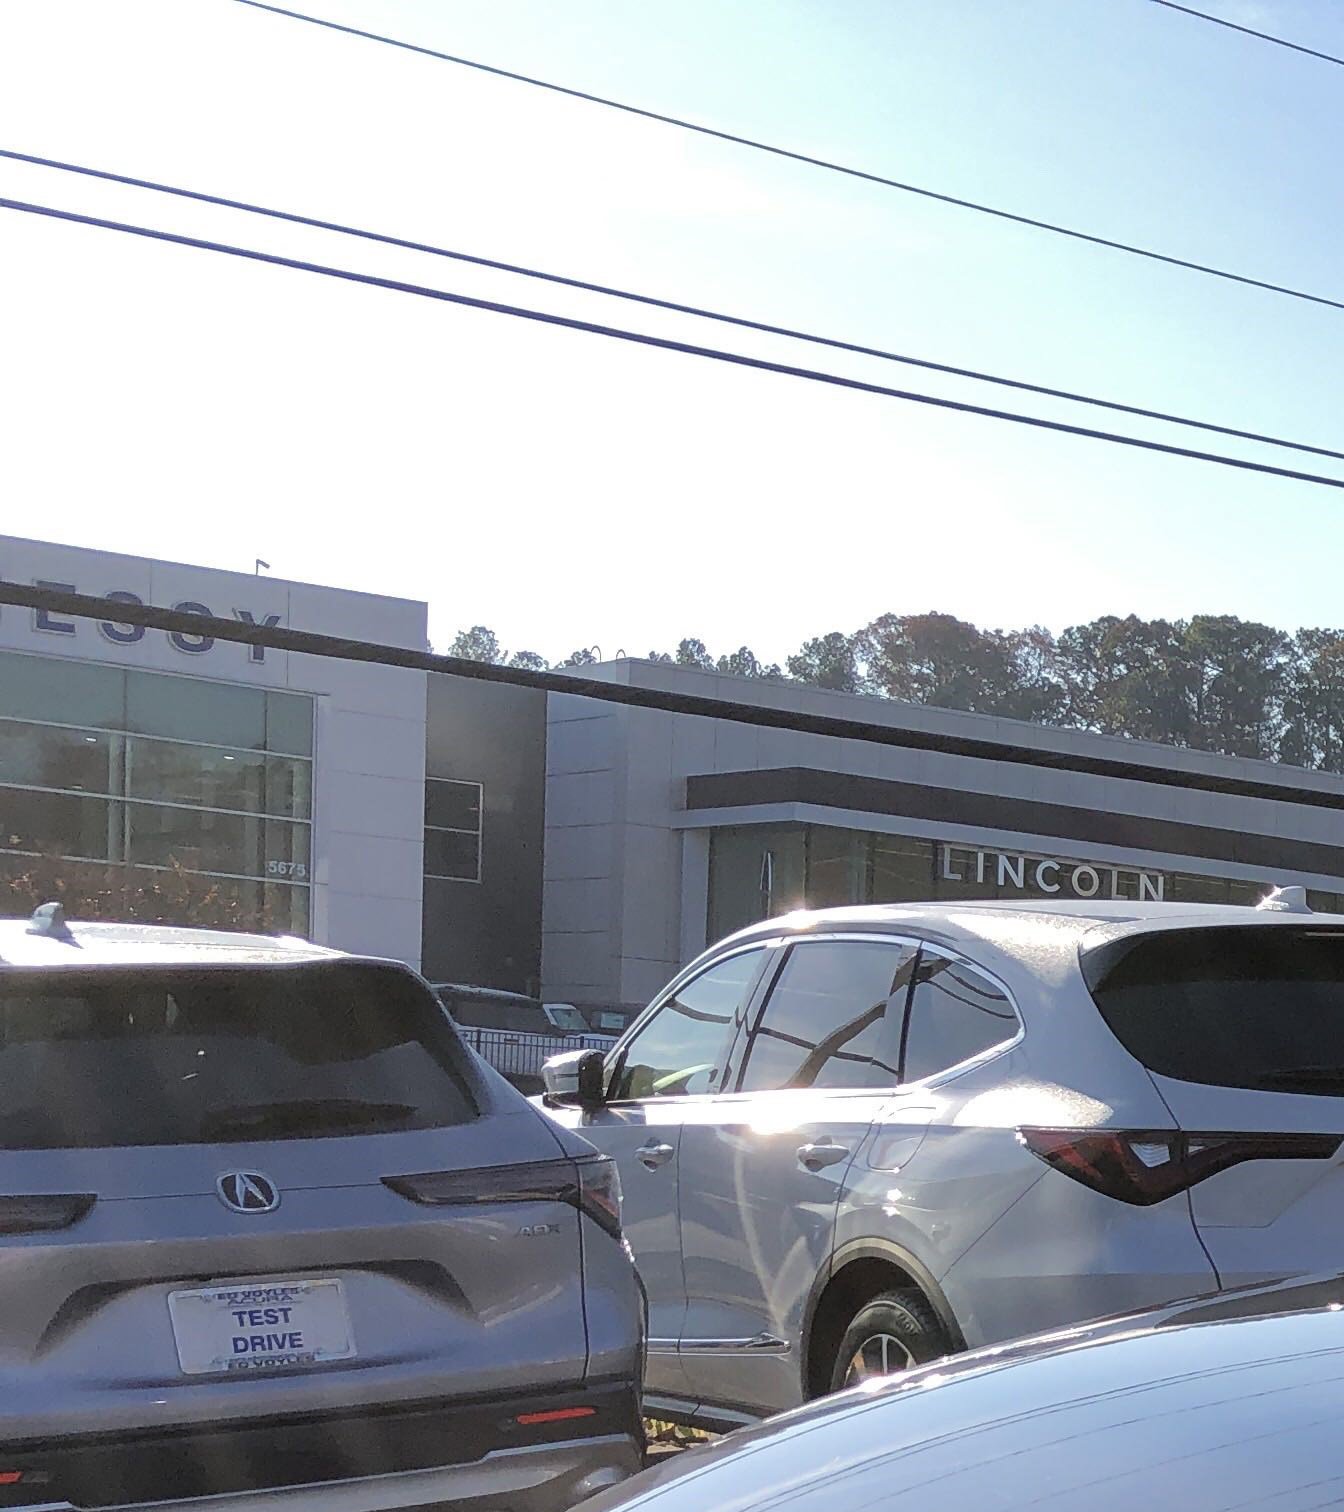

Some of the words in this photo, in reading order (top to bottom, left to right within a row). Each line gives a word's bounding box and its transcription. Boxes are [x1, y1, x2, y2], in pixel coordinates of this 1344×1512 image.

[942, 846, 1165, 902] LINCOLN
[232, 1307, 292, 1327] TEST
[232, 1332, 304, 1354] DRIVE
